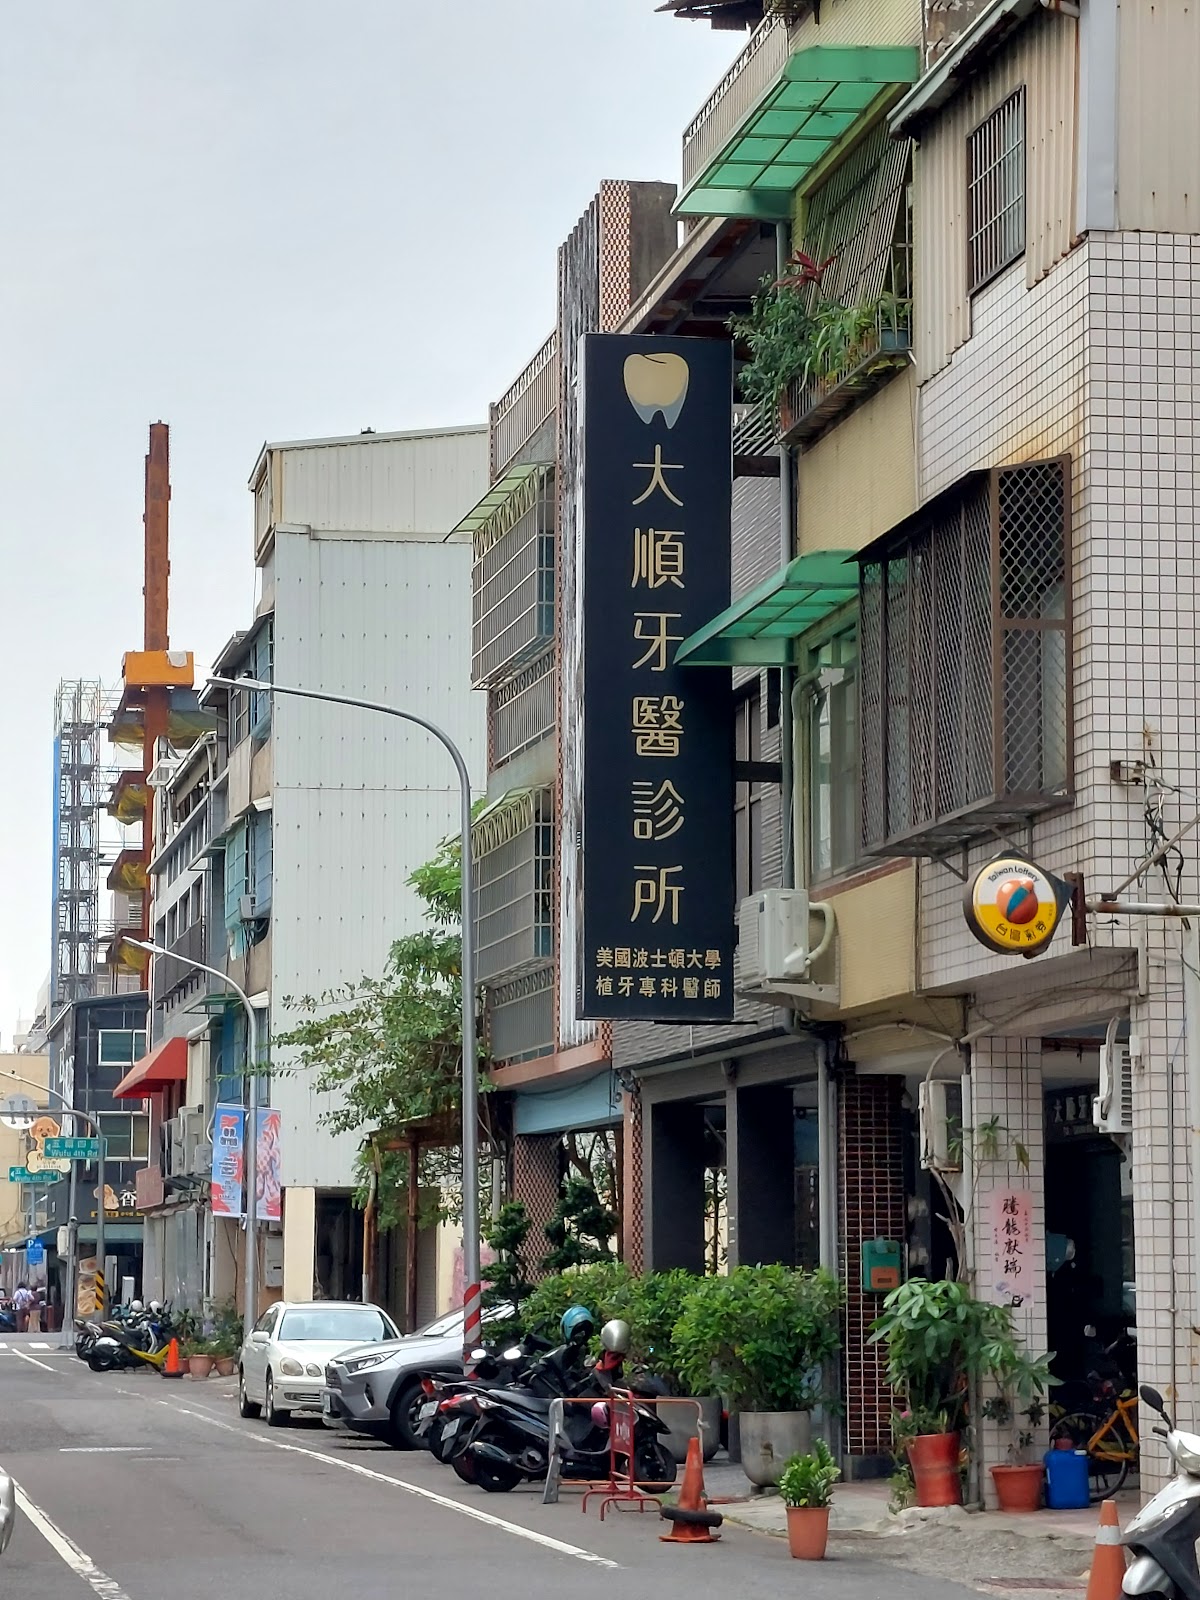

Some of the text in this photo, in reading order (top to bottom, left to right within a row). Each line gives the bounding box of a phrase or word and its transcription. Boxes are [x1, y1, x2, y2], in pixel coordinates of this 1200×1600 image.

[631, 444, 685, 925] 大順牙醫診所
[988, 865, 1040, 882] Taiwan Lottery
[995, 920, 1047, 942] 台灣彩券
[596, 946, 722, 970] 美國波士頓大學
[595, 975, 722, 999] 植牙專科醫師
[51, 1149, 98, 1157] Wufu 4th Rd
[27, 1239, 35, 1248] P
